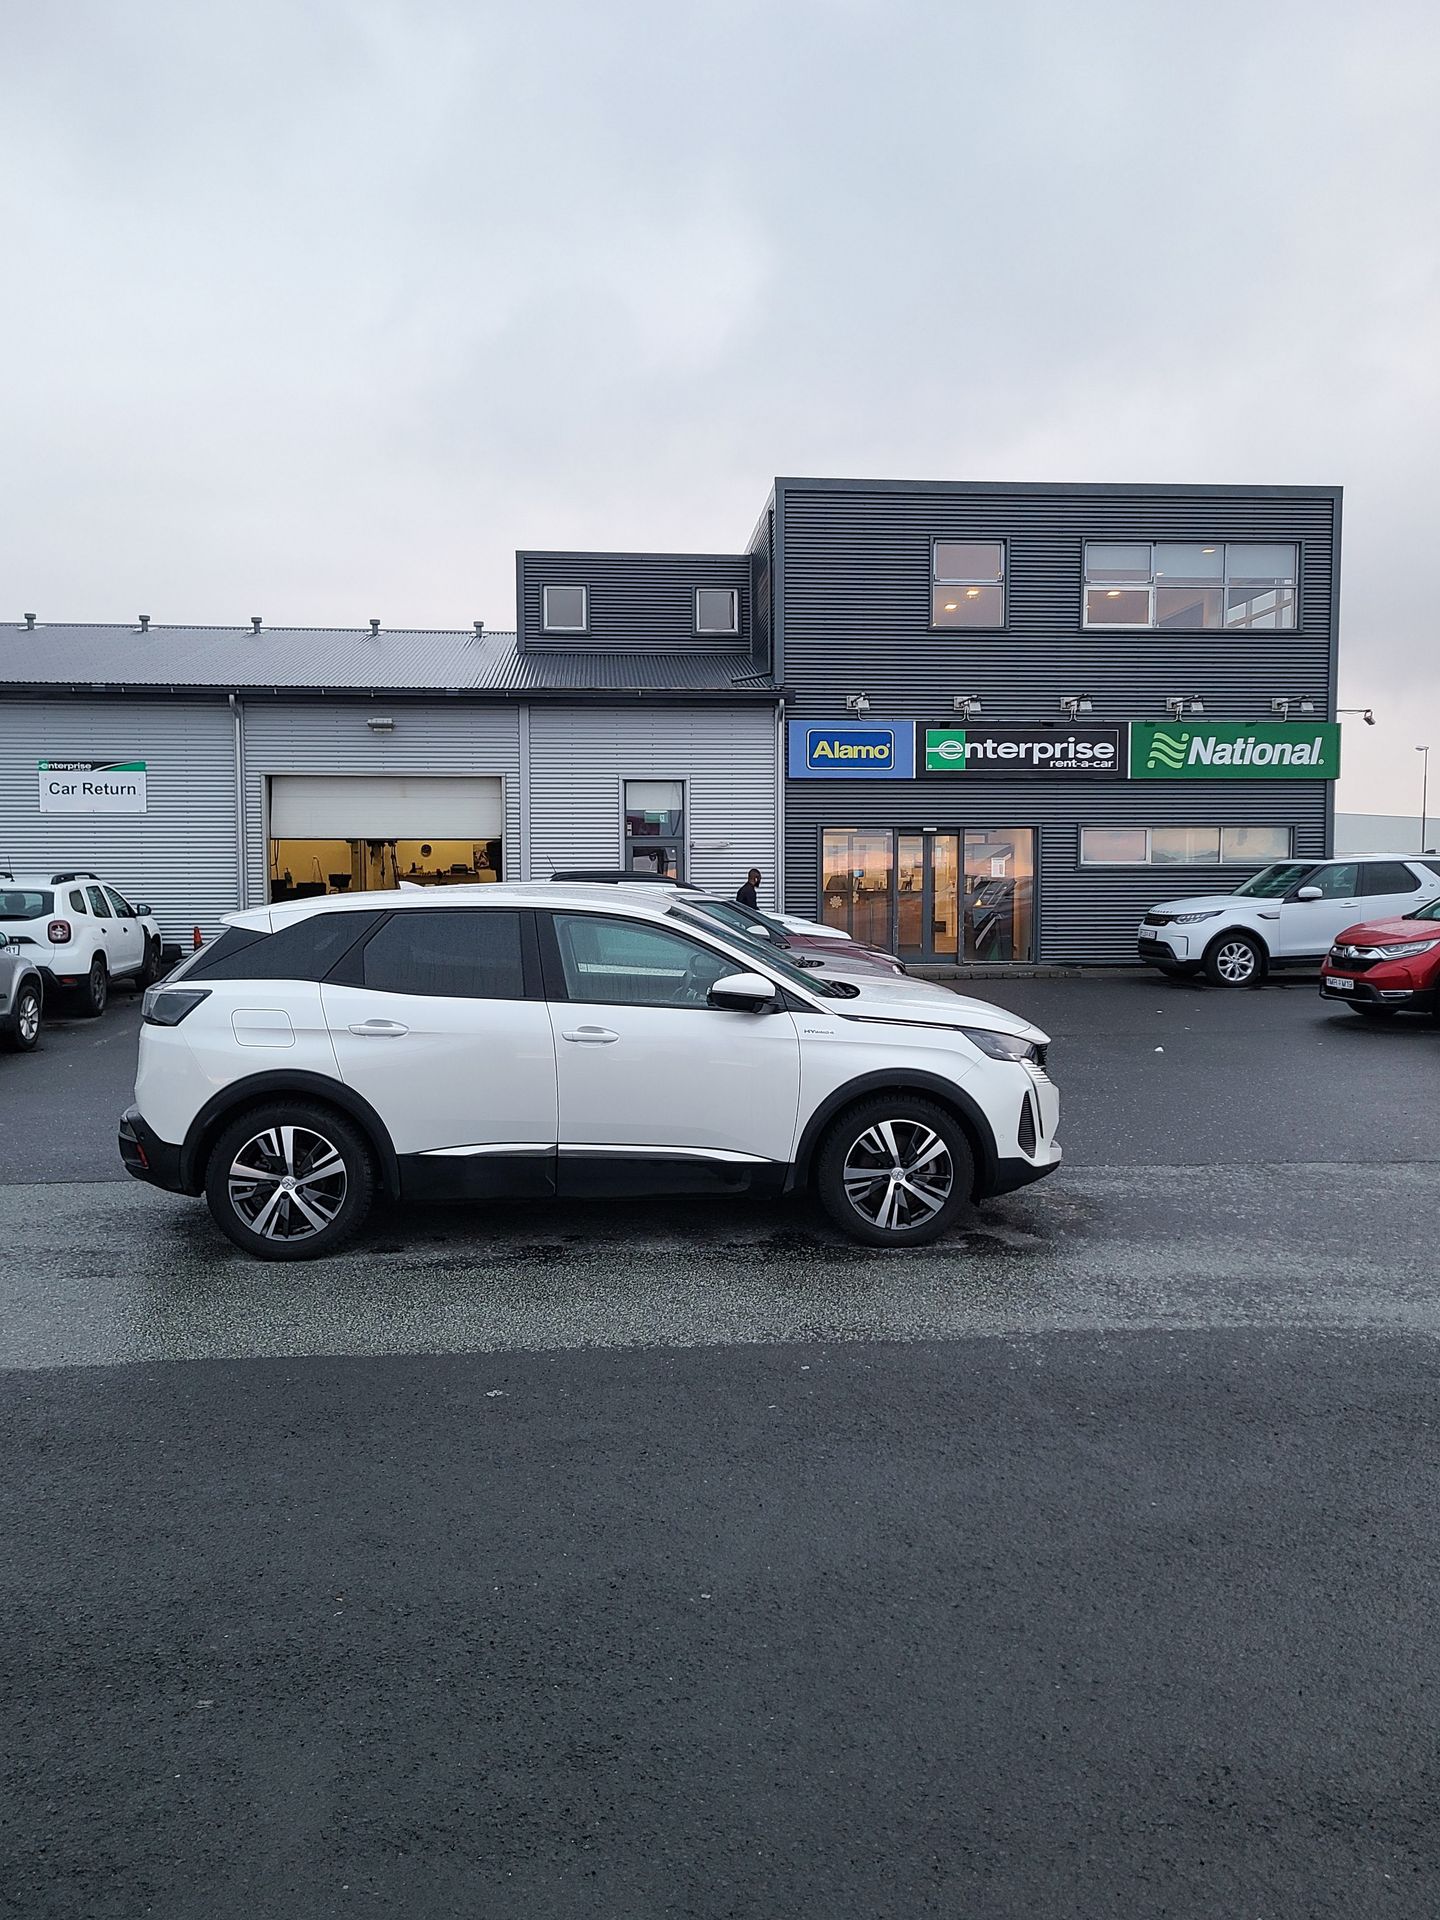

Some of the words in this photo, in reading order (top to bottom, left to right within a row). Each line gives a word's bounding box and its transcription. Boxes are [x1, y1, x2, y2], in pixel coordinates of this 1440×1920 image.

[812, 740, 890, 759] Alamo
[938, 737, 1115, 765] enterprise
[41, 762, 92, 770] enterprise
[1050, 759, 1114, 768] rent-a-car
[49, 782, 77, 795] Car
[82, 782, 136, 795] Return
